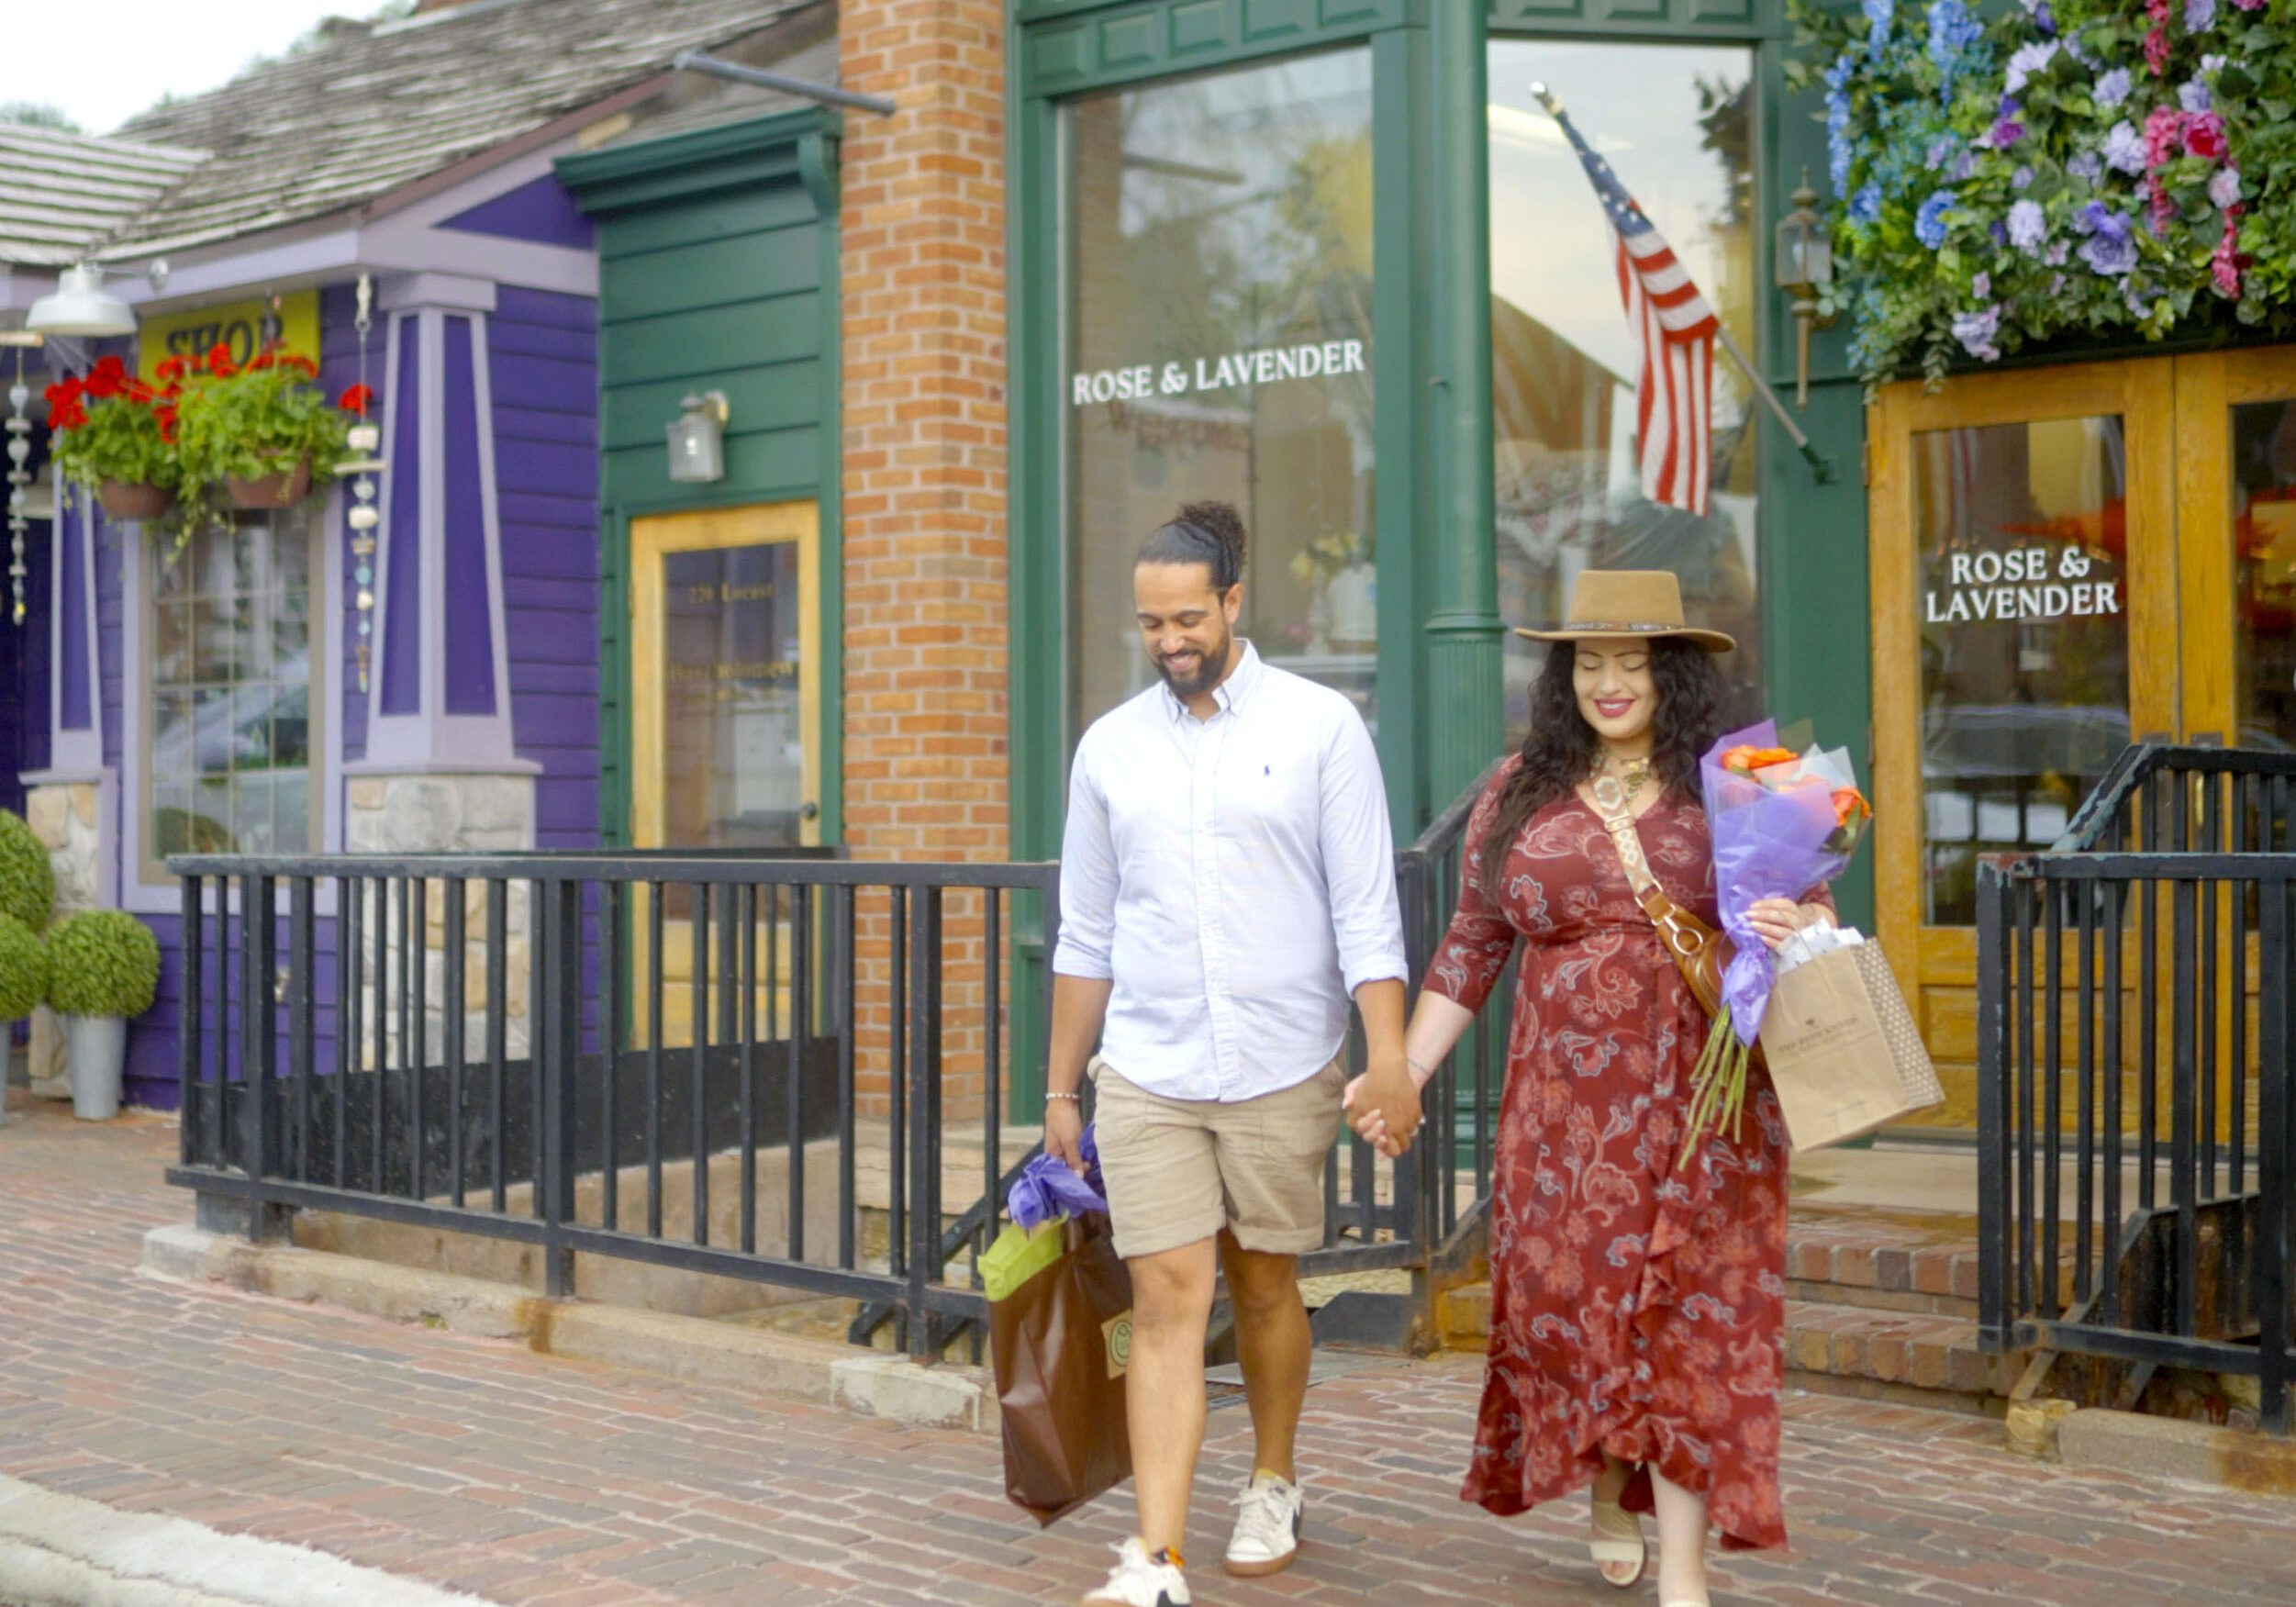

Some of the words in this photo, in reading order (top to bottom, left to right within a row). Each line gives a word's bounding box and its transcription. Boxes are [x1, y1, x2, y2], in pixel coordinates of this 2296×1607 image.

[1073, 365, 1154, 405] ROSE
[1160, 361, 1188, 395] &
[1196, 340, 1365, 390] LAVENDER
[1951, 548, 2048, 585] ROSE
[2058, 546, 2090, 578] &
[1926, 582, 2119, 622] LAVENDER
